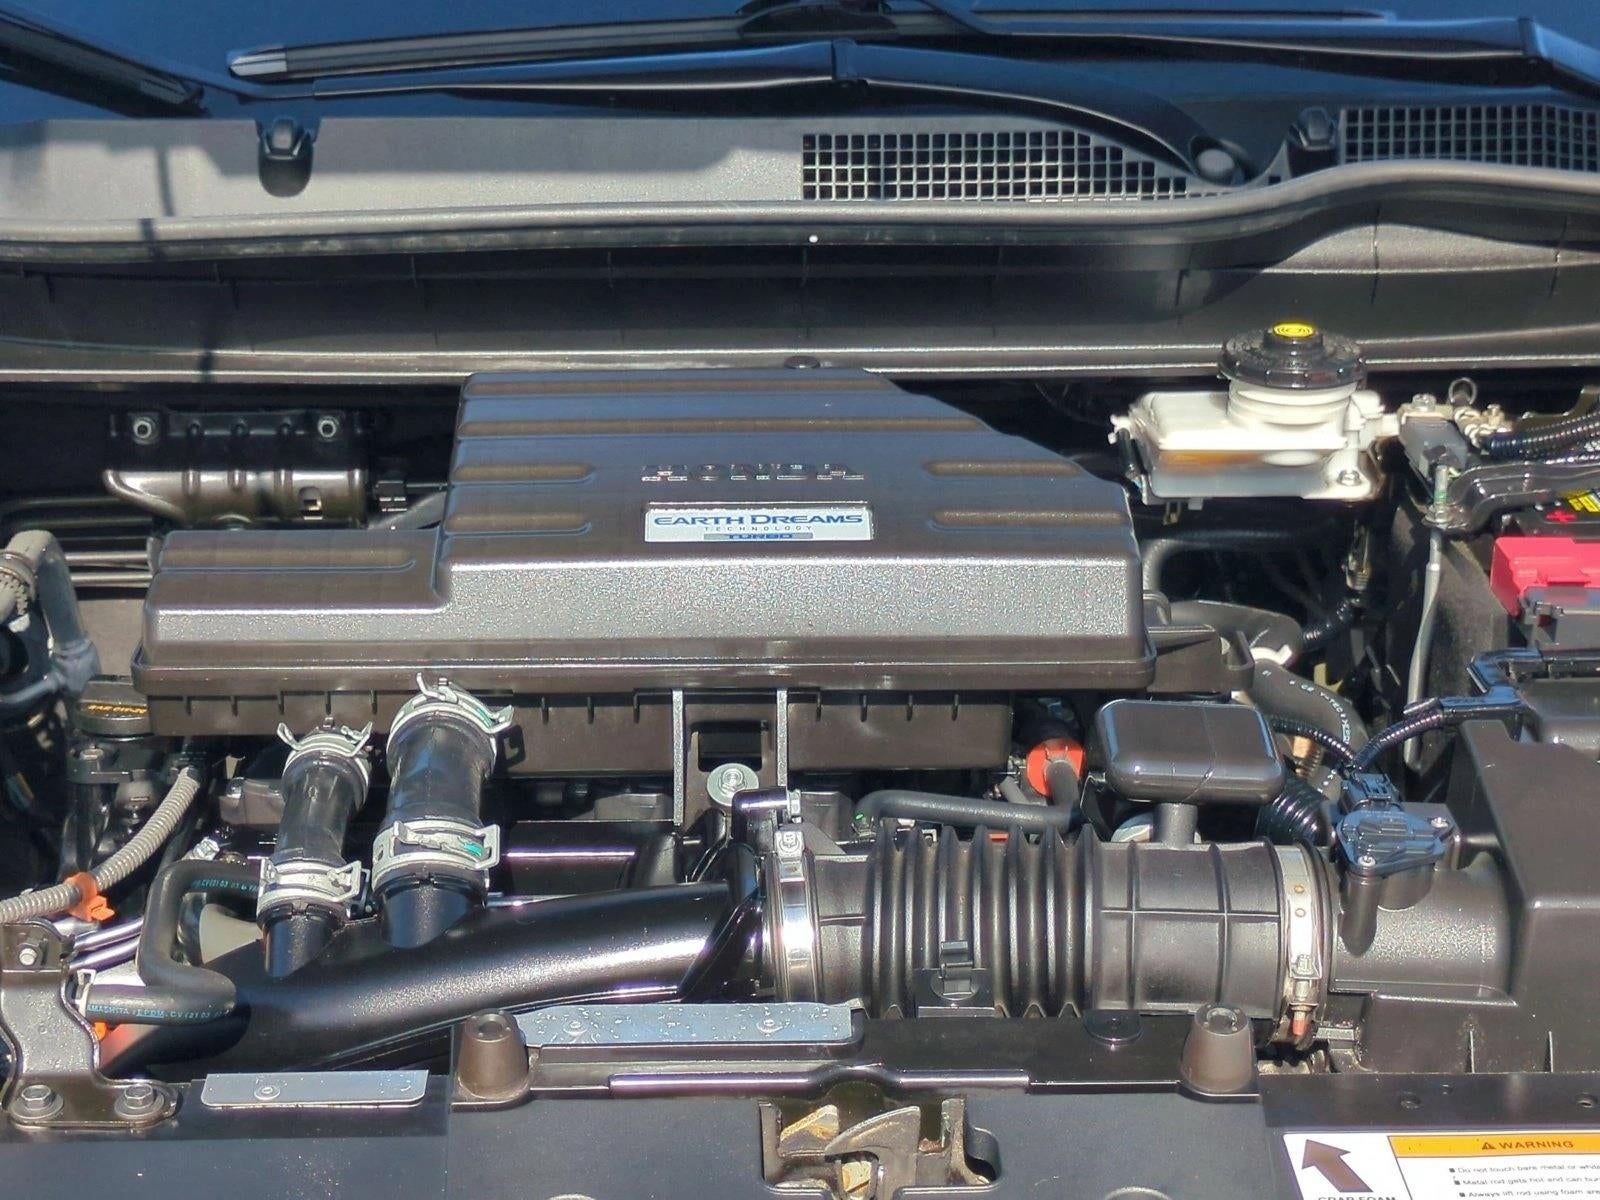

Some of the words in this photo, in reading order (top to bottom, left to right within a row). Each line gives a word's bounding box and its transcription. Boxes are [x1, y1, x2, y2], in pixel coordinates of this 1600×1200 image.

[654, 515, 745, 526] EARTH
[751, 514, 863, 525] DREAMS
[729, 532, 794, 540] TURBO
[1499, 1140, 1575, 1150] WARNING
